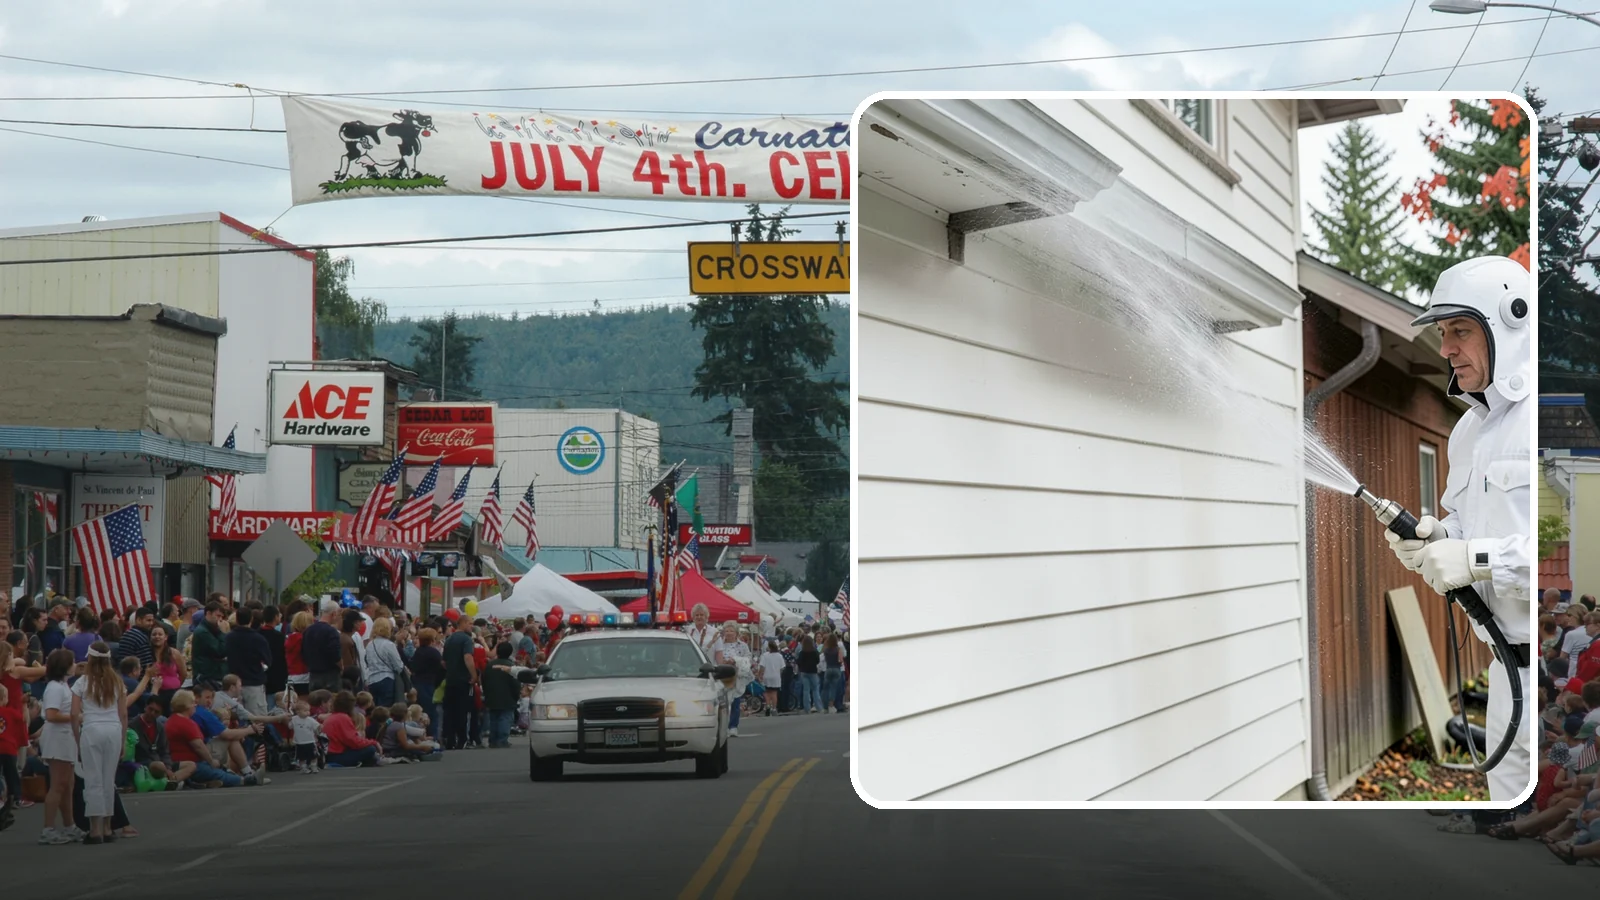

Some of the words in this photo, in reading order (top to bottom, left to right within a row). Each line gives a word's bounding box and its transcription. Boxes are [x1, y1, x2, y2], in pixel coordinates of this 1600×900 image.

[695, 122, 850, 149] Carnat
[481, 141, 605, 192] JULY
[633, 150, 746, 197] 4th.
[697, 254, 850, 280] CROSSWA
[283, 380, 373, 420] ACE
[406, 409, 453, 423] CEDAR
[461, 409, 486, 422] LOG
[283, 421, 371, 436] Hardware
[416, 427, 477, 447] Coca-Cola
[353, 466, 384, 480] Simpl
[95, 485, 124, 495] Vincent
[126, 486, 136, 495] de
[137, 486, 155, 496] Paul
[688, 526, 742, 535] CRNATION
[699, 535, 730, 543] GLASS
